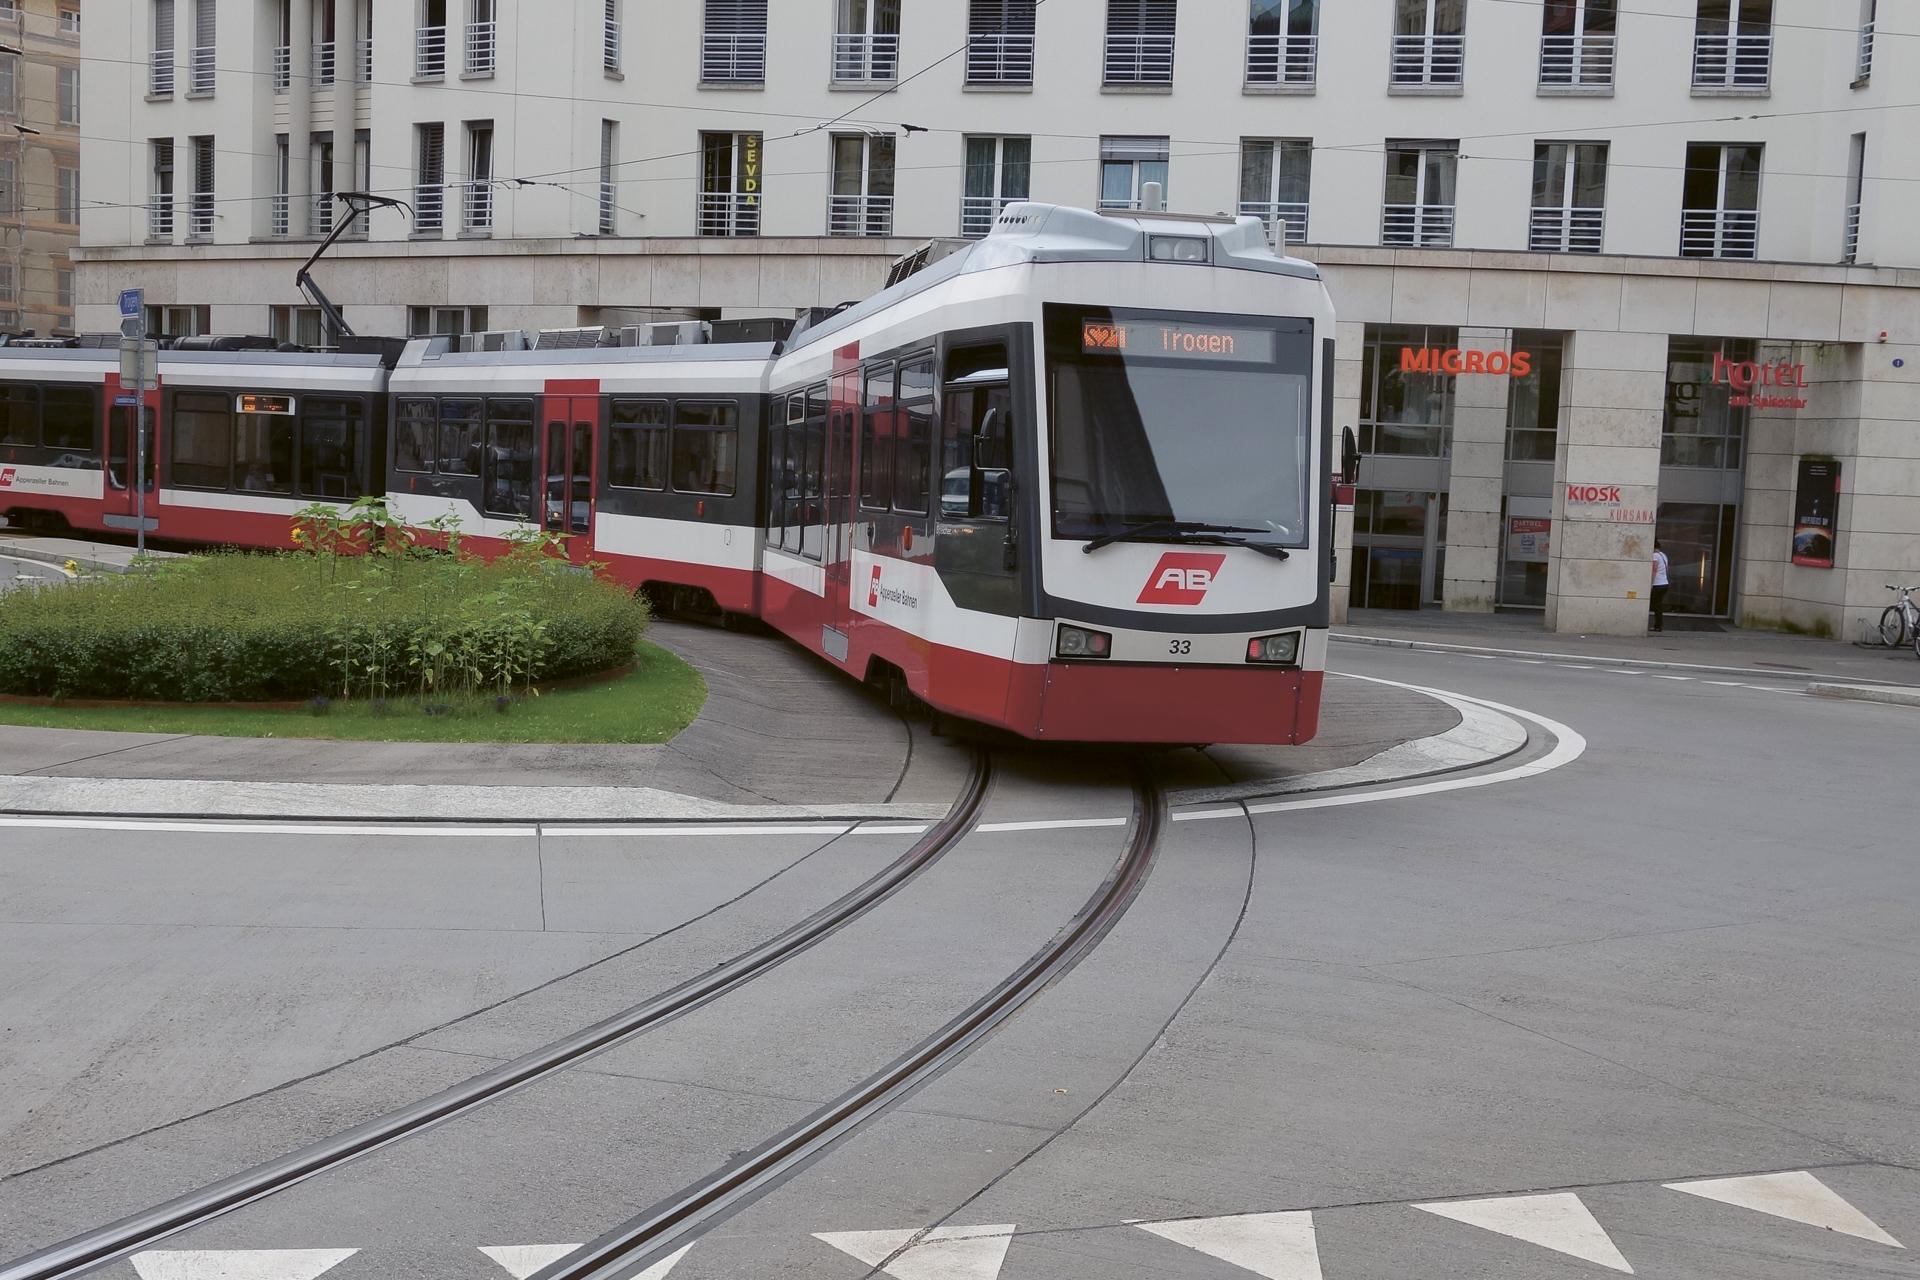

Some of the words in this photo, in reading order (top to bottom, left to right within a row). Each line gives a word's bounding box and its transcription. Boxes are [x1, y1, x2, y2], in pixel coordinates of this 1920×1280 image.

[745, 135, 757, 206] SEVDA
[1400, 346, 1531, 376] MIGROS
[1712, 352, 1809, 391] hotel
[1568, 485, 1621, 502] KIOSK
[1609, 508, 1655, 522] KURSANA
[1155, 568, 1212, 590] AB
[901, 589, 918, 609] Bahnen
[1168, 639, 1192, 659] 33
